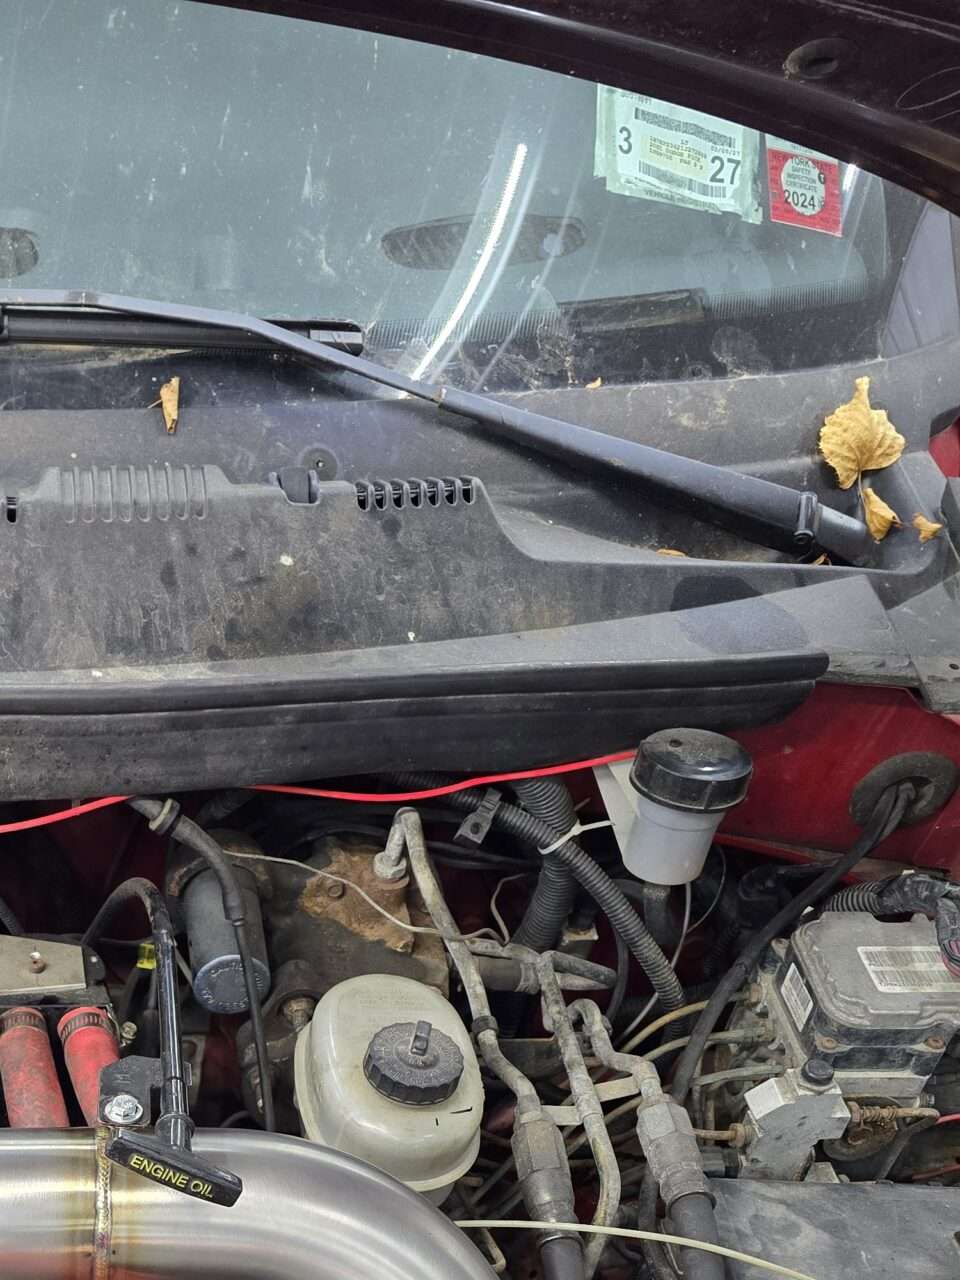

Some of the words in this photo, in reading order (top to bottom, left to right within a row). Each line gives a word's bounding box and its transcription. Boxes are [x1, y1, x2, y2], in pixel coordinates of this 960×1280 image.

[618, 126, 633, 155] 3
[709, 156, 742, 185] 27
[783, 189, 816, 211] 2024
[129, 1155, 189, 1188] ENGINE
[190, 1180, 214, 1198] OIL
